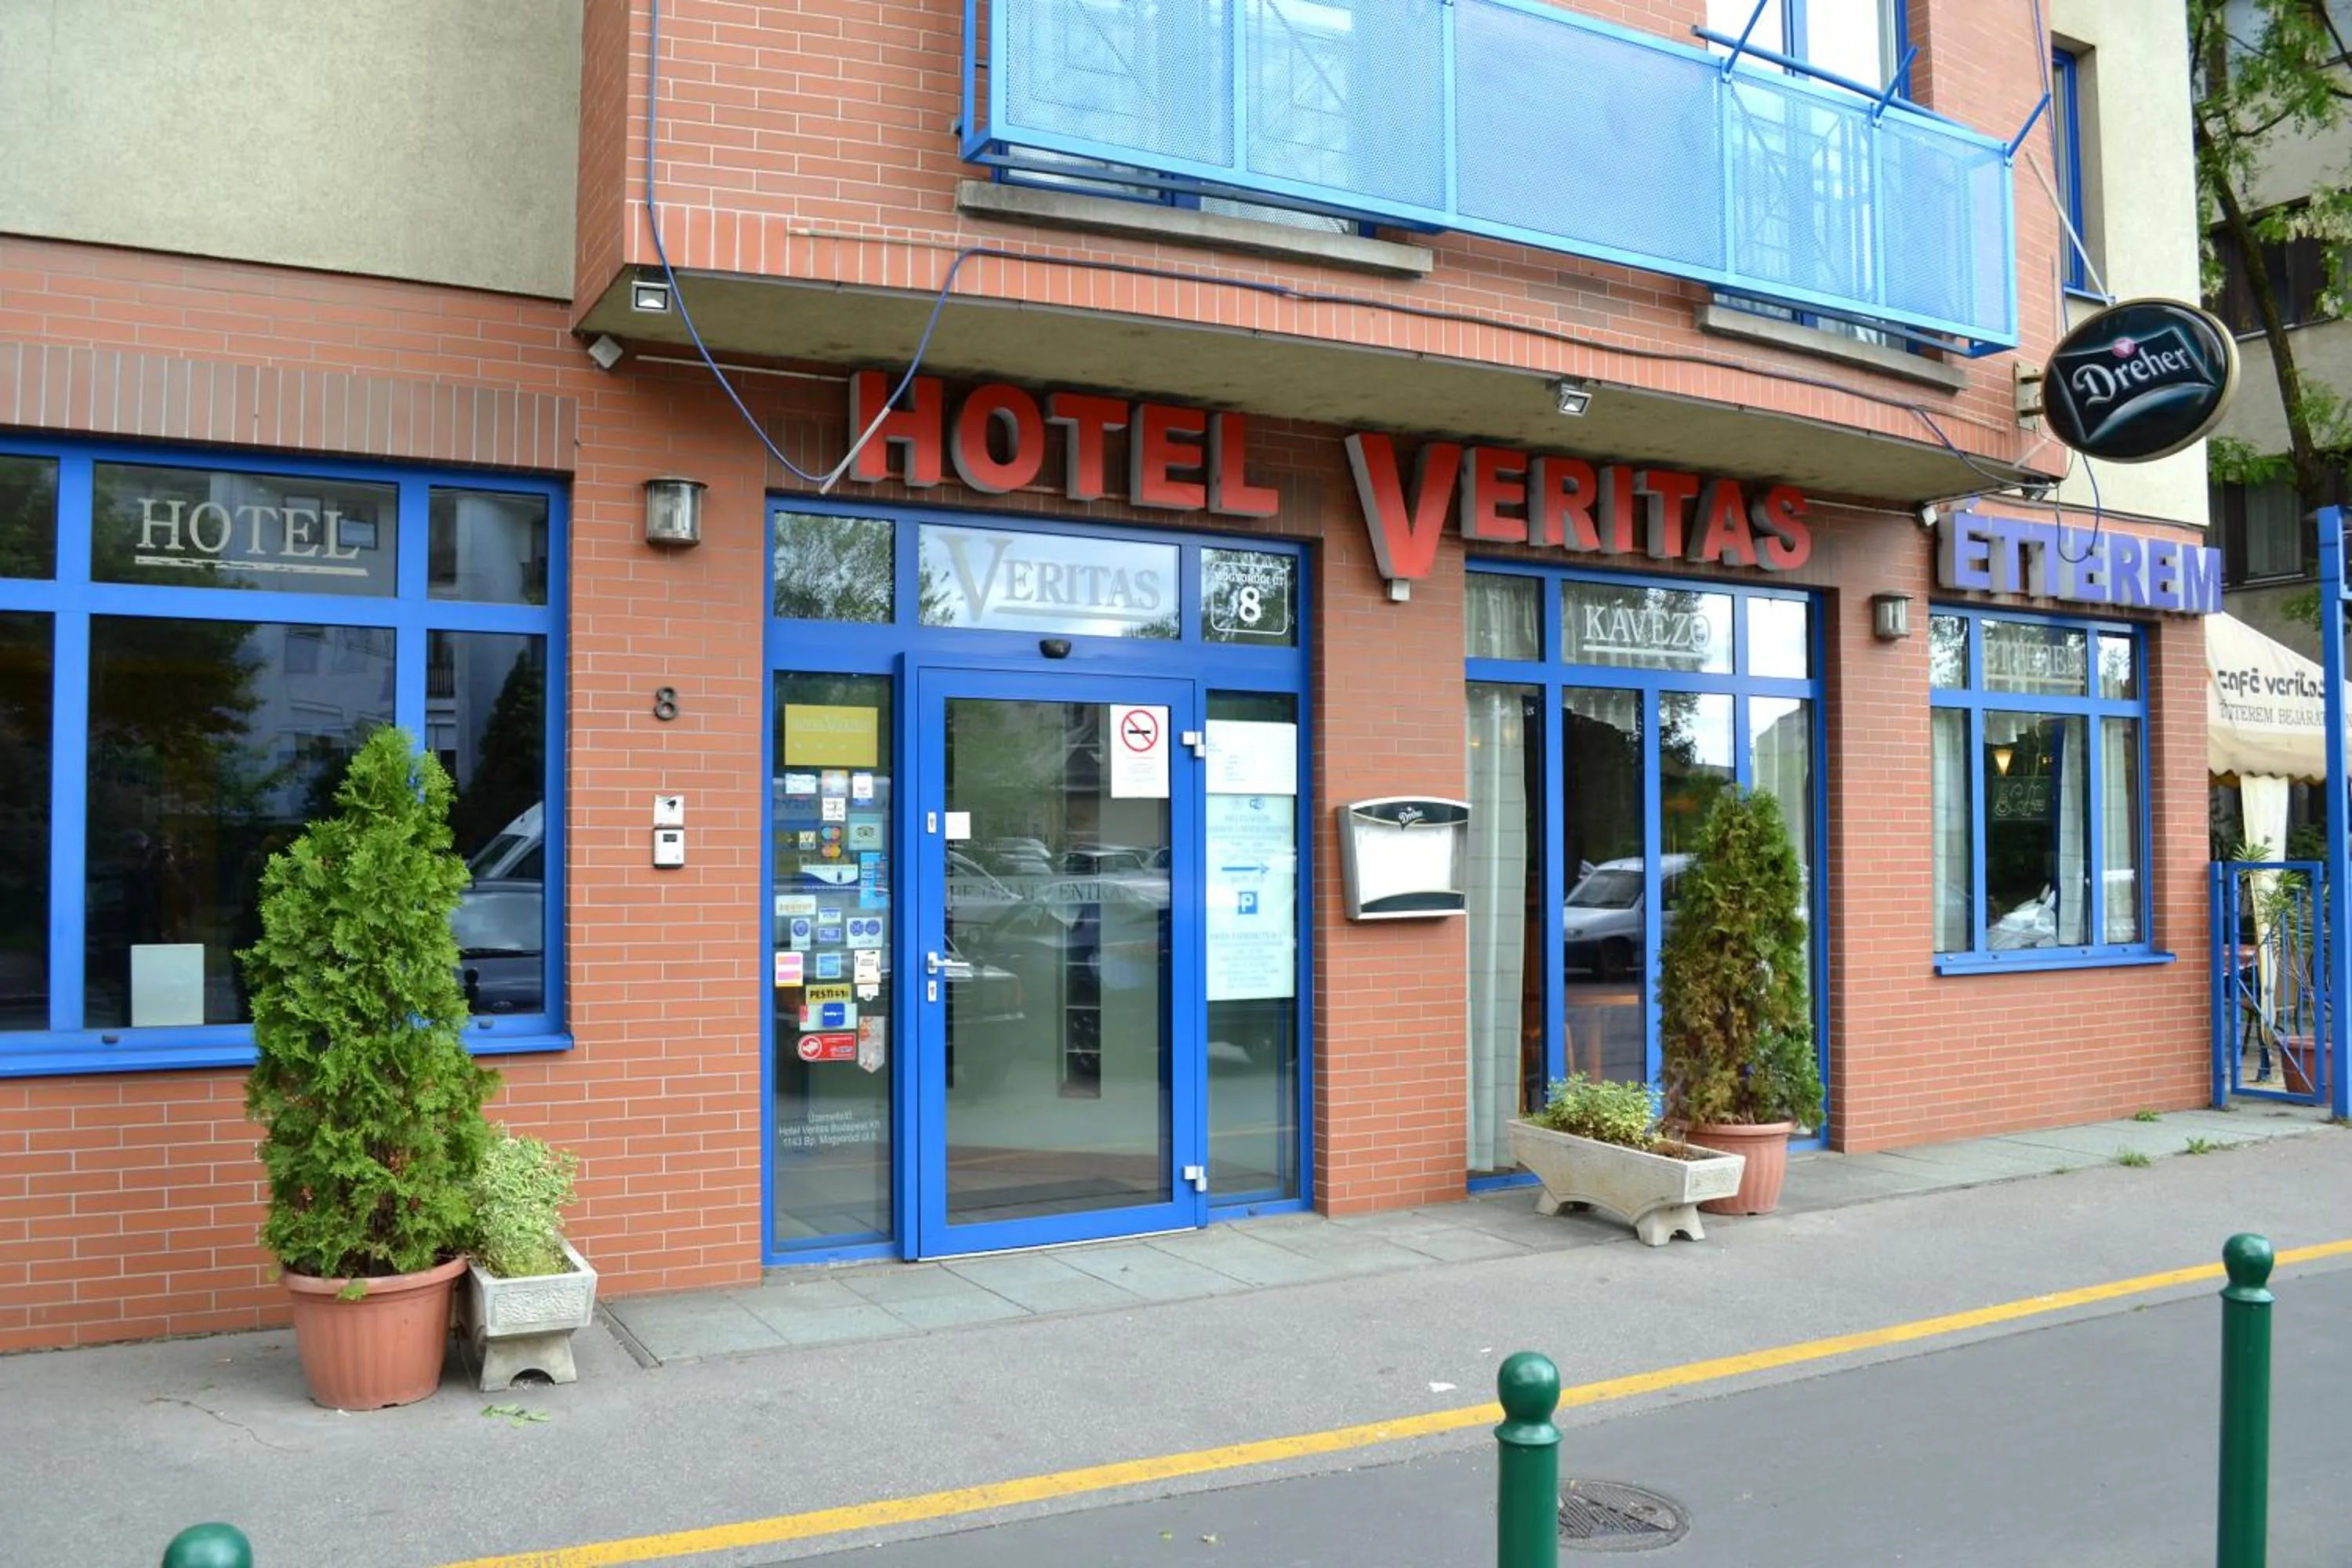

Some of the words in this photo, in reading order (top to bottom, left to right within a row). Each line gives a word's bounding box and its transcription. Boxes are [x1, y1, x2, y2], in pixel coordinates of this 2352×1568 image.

[2072, 346, 2192, 407] Dreher
[849, 370, 1279, 517] HOTEL
[1345, 433, 1812, 579] VERITAS
[136, 498, 361, 560] HOTEL
[938, 534, 1161, 621] VERITAS
[1240, 586, 1261, 622] 8
[654, 687, 678, 721] 8
